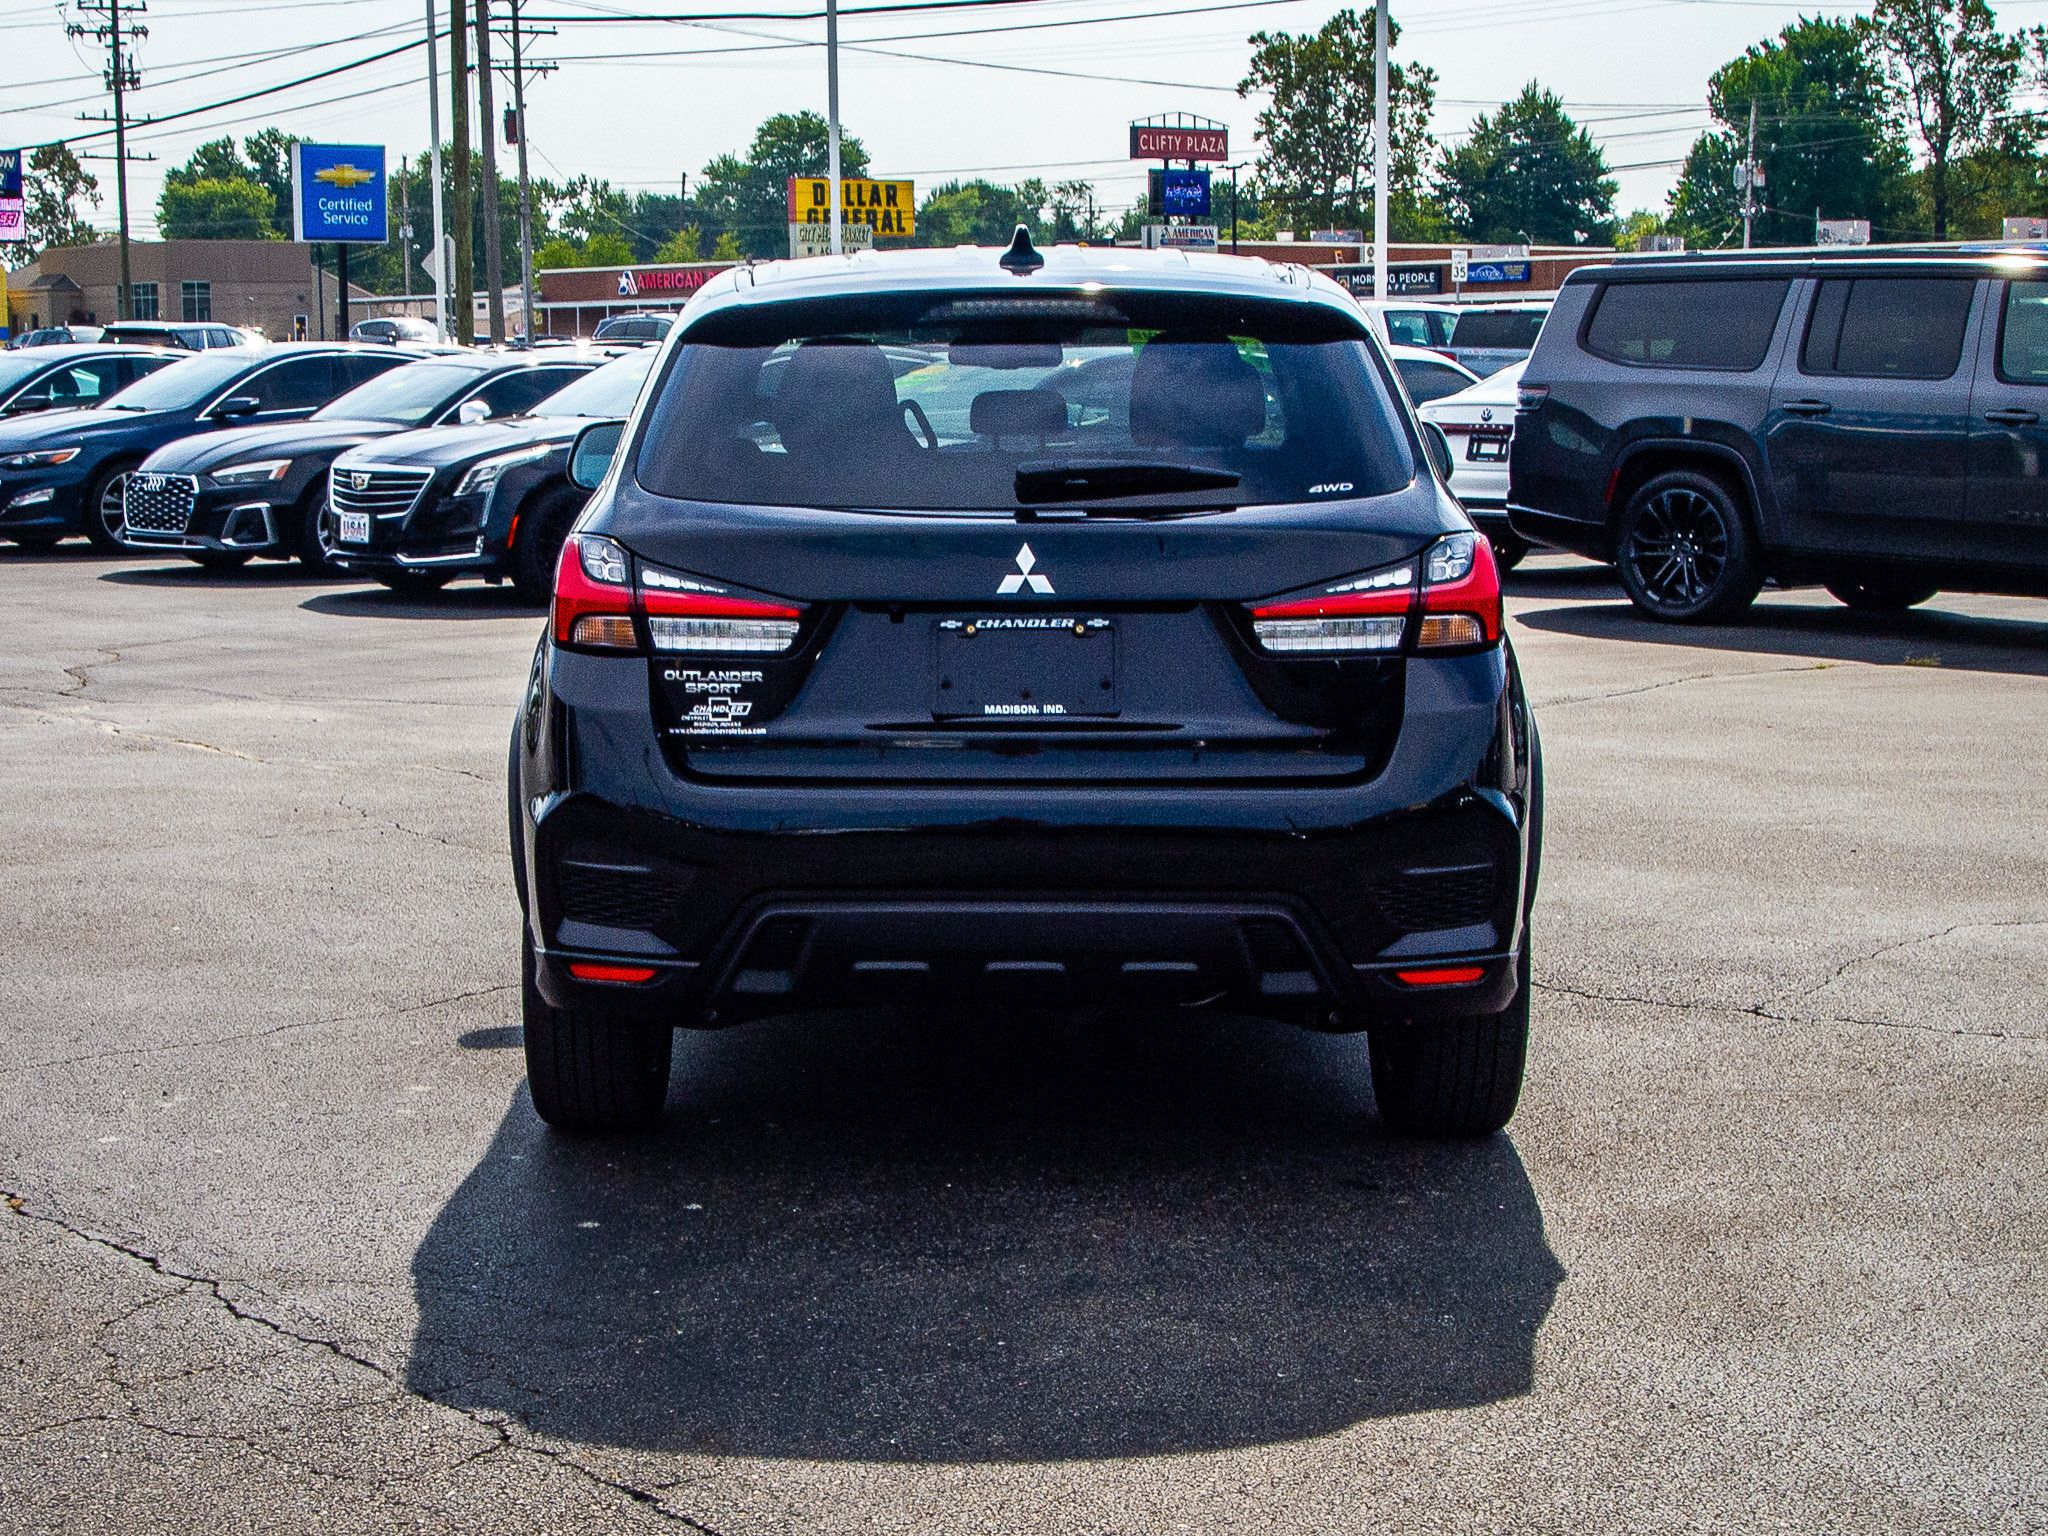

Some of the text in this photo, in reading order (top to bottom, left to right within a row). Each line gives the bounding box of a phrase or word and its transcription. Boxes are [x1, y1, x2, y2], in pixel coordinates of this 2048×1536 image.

[1140, 134, 1225, 153] CLIFTY PLAZA
[813, 182, 898, 207] DLLAR
[318, 197, 373, 212] Certified
[323, 211, 369, 225] Service
[1352, 272, 1435, 285] MORNG PEOPLE
[1453, 266, 1466, 279] 35
[637, 271, 703, 290] AMERICAN
[1309, 482, 1354, 493] 4WD
[975, 618, 1075, 629] CHANDLER
[664, 669, 763, 682] OUTLANDER
[685, 682, 741, 694] SPORT
[692, 704, 744, 714] CHANDLER
[1043, 705, 1067, 714] IND.
